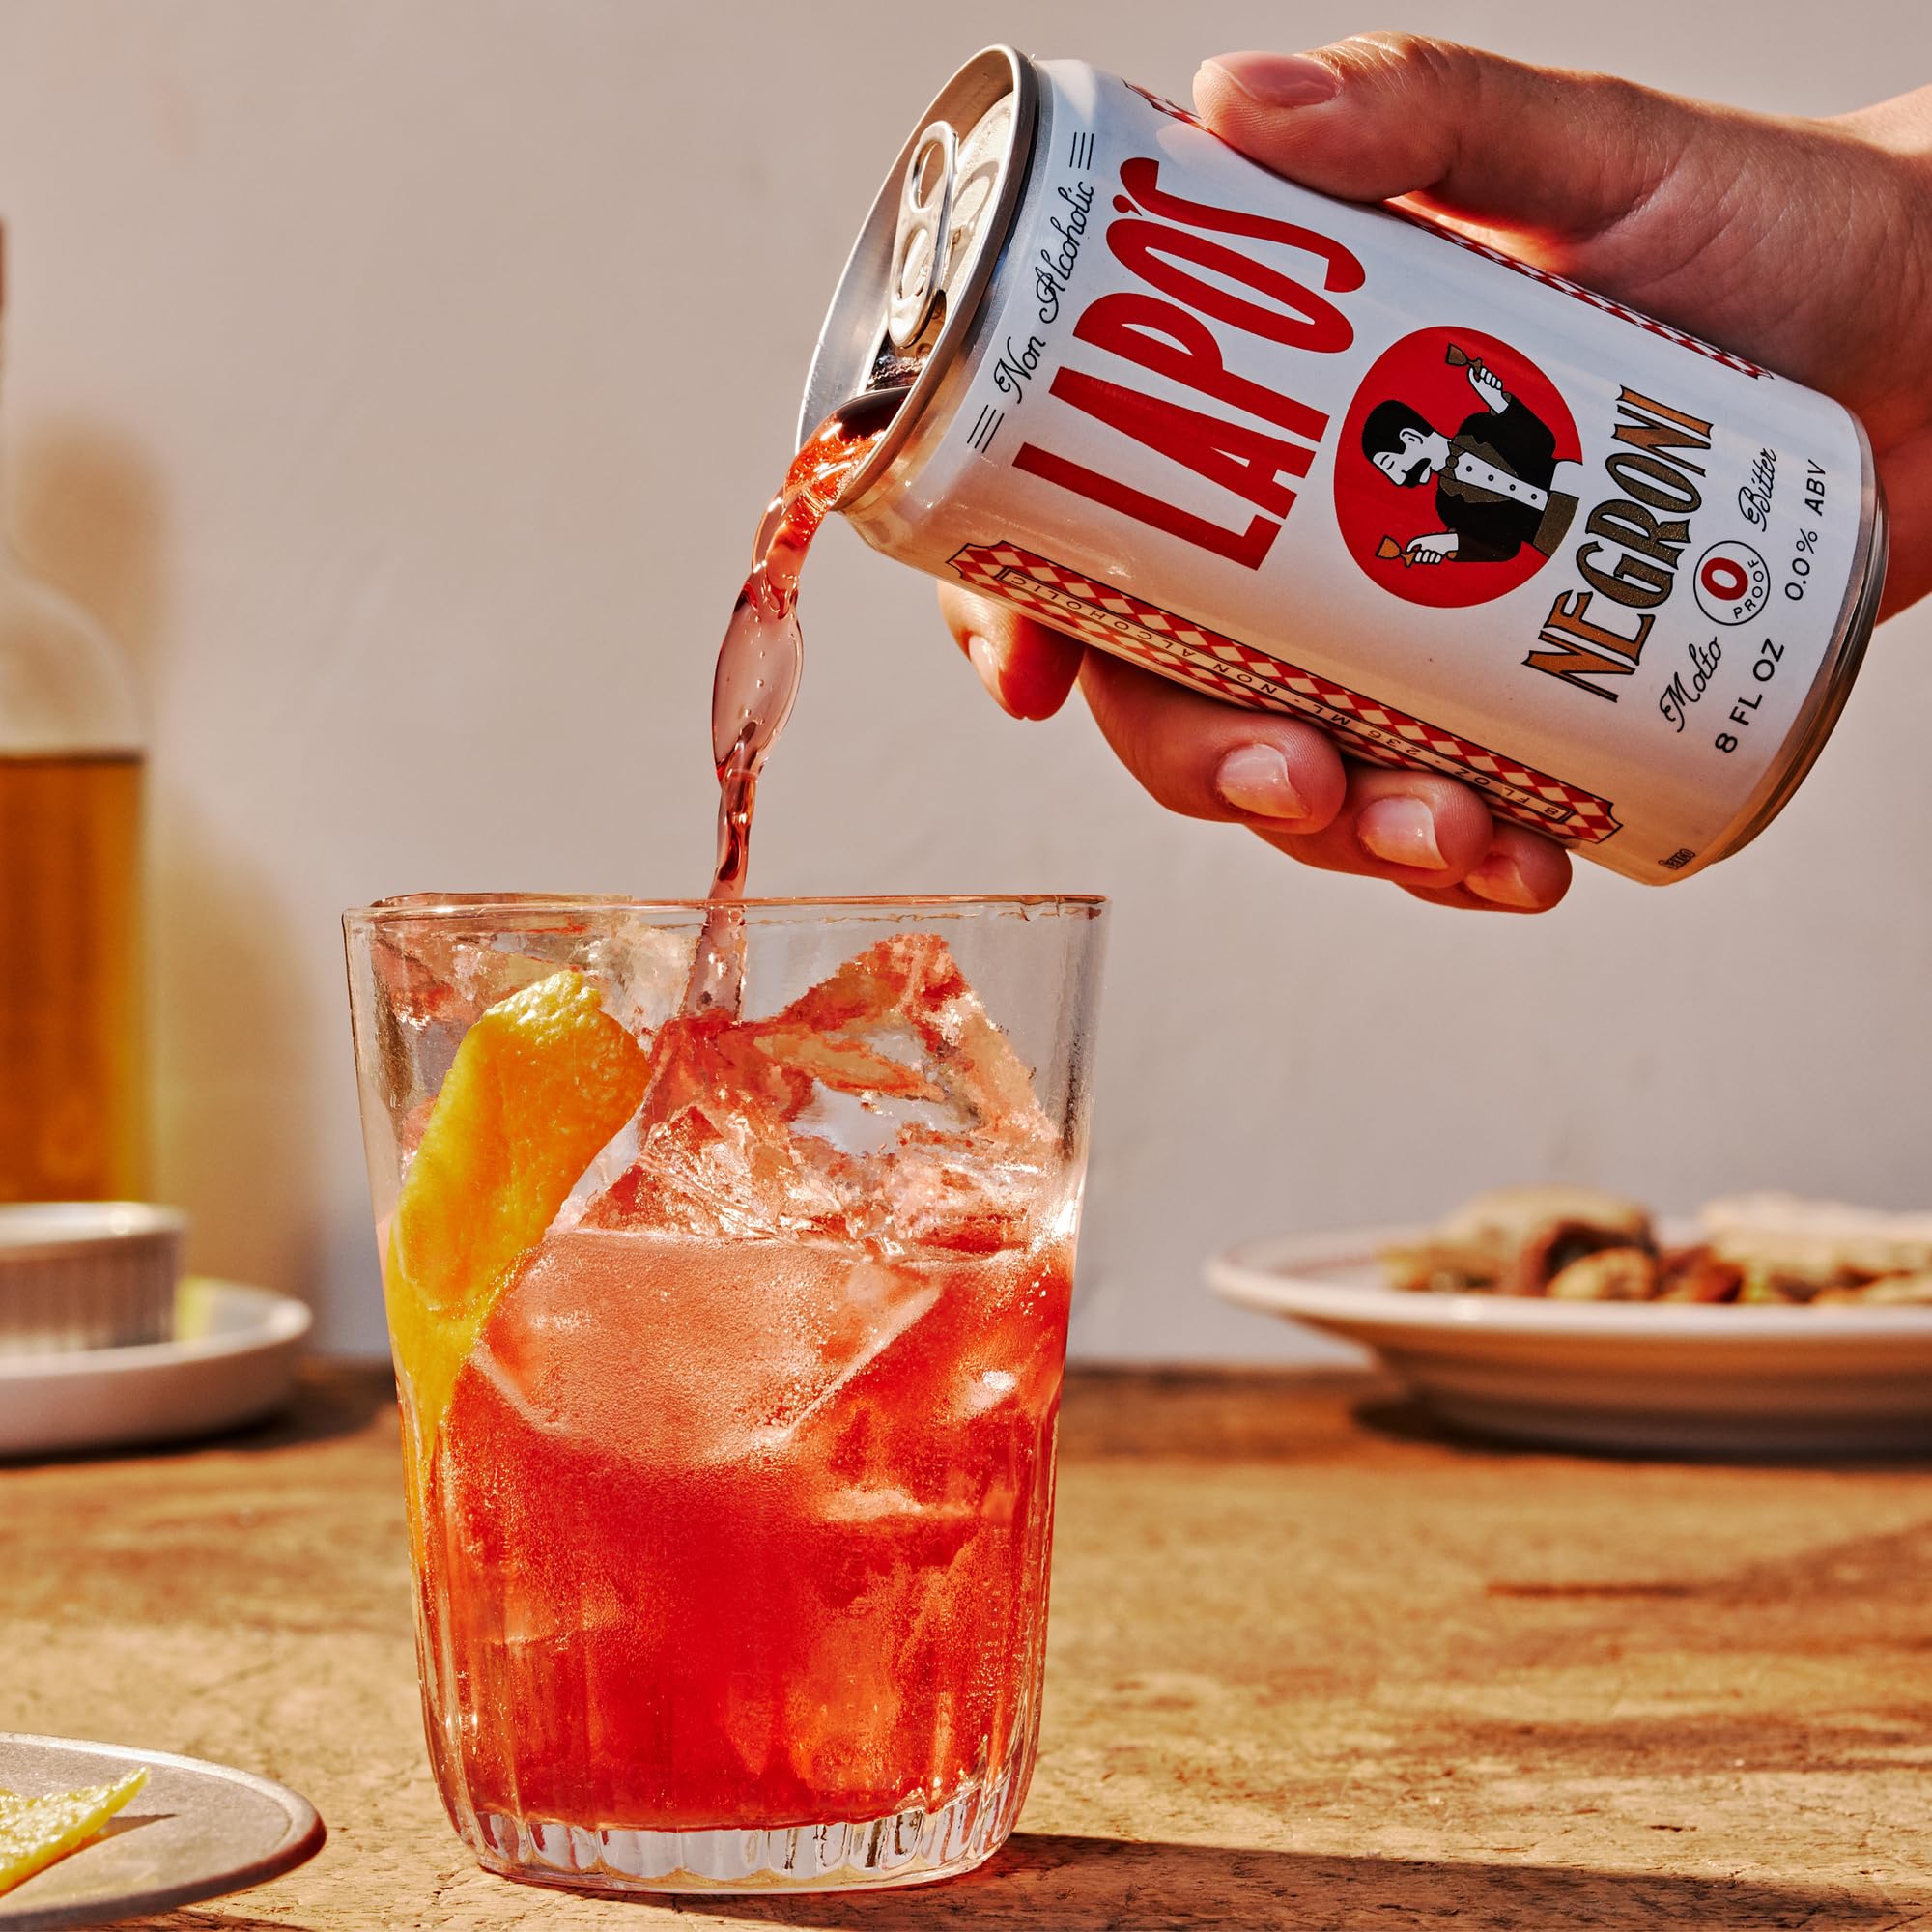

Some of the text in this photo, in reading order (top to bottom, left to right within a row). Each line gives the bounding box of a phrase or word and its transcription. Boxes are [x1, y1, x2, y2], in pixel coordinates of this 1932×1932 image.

[994, 181, 1094, 404] Non Alcoholic
[1521, 384, 1715, 703] NEGRONI
[1659, 448, 1776, 733] Molto Bitter
[1700, 556, 1749, 601] 0
[1733, 559, 1764, 619] PROOF
[1784, 458, 1826, 601] 0.0% ABV
[1009, 575, 1560, 816] 8 FL OZ 236 ML NON ALCOHOLIC
[1715, 638, 1785, 753] 8 FL OZ
